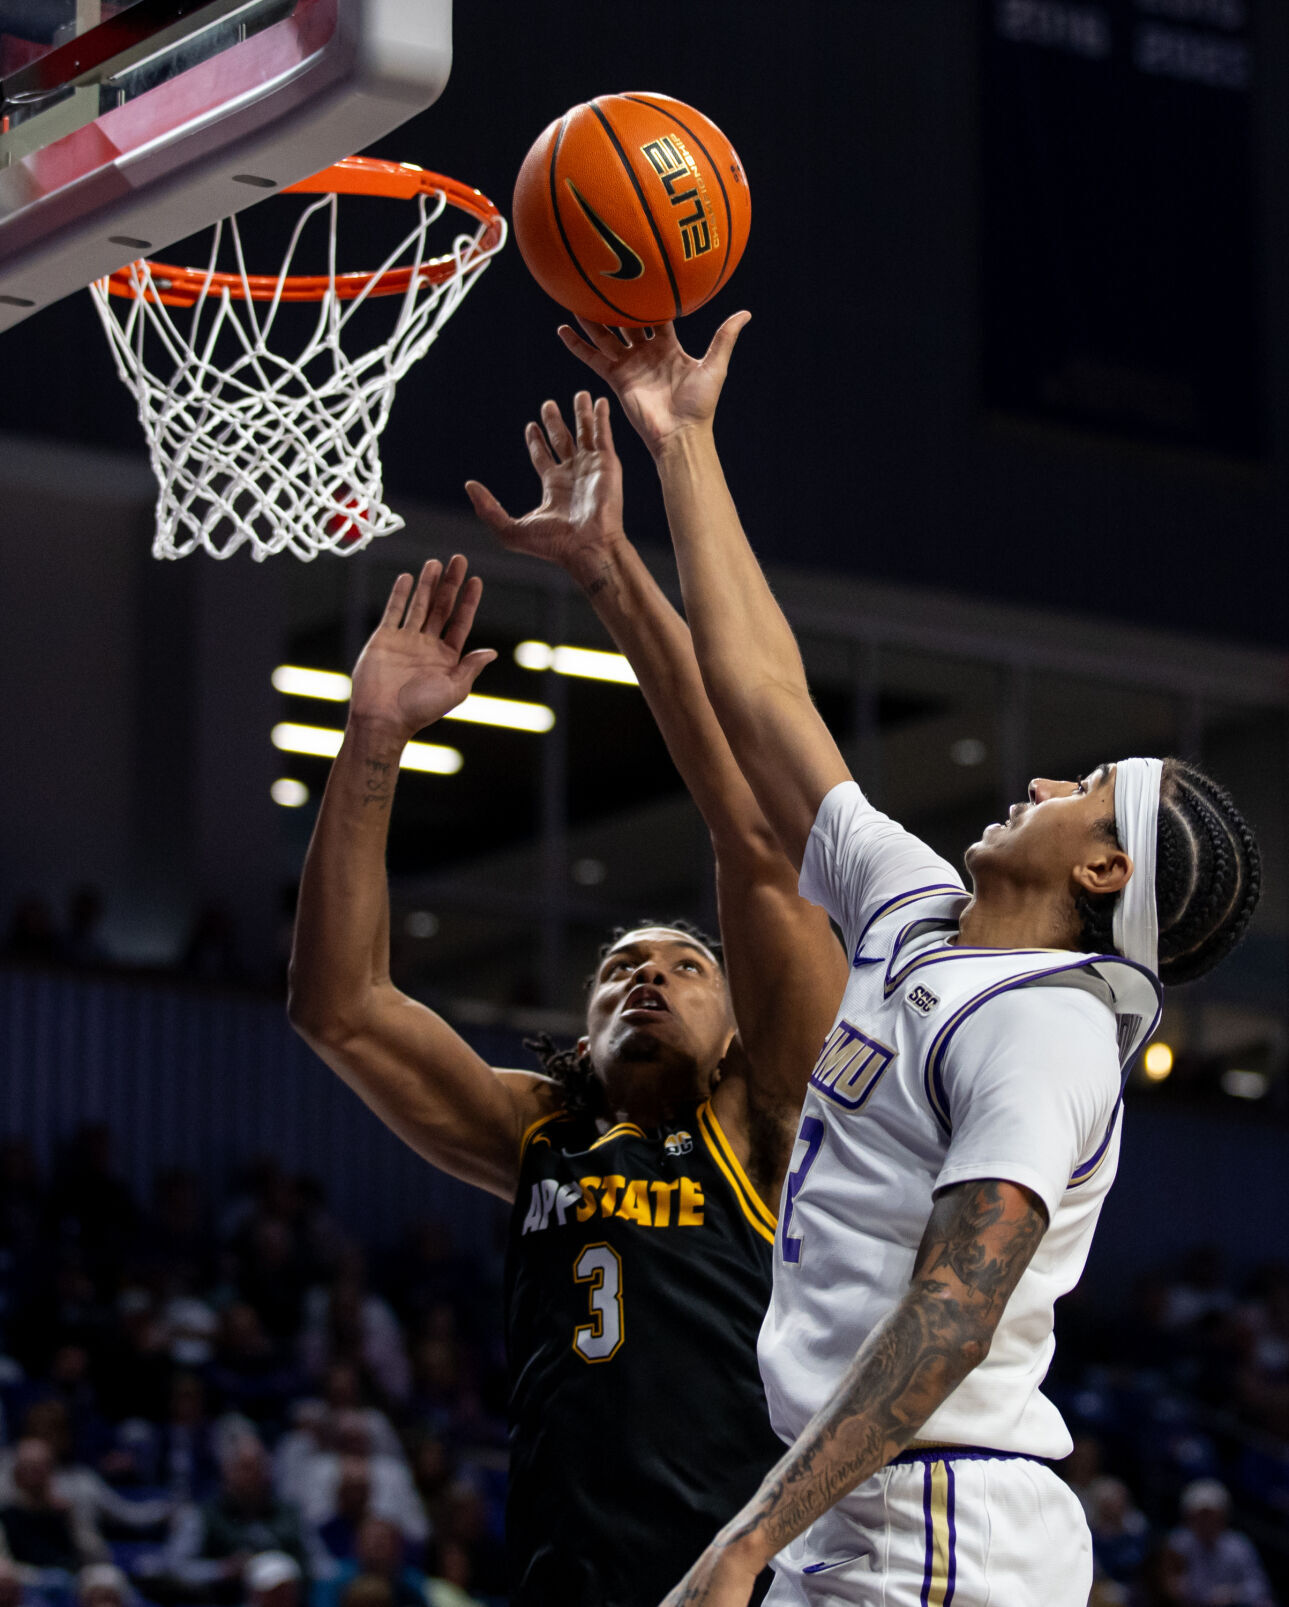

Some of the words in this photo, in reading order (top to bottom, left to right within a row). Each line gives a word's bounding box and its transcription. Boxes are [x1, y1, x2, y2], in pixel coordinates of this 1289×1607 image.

[640, 135, 713, 262] ELITE
[782, 1114, 825, 1264] 2
[572, 1241, 625, 1364] 3
